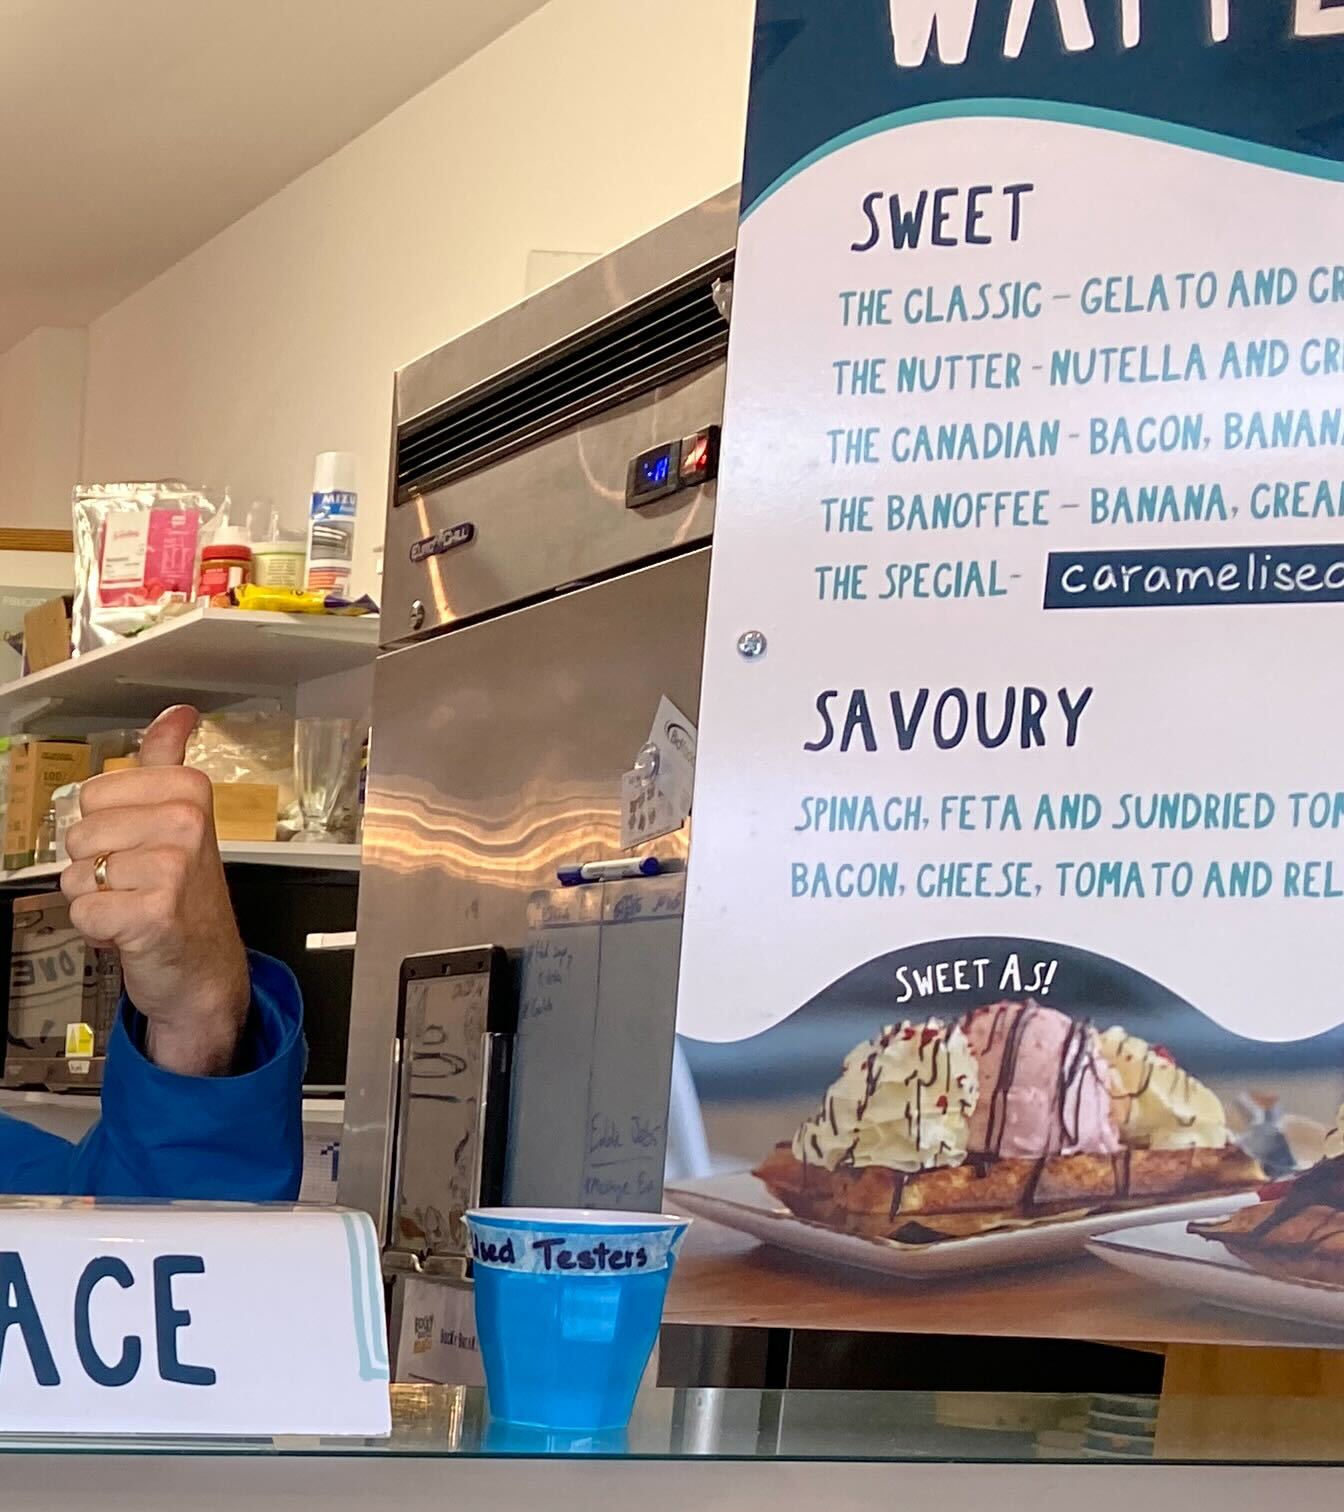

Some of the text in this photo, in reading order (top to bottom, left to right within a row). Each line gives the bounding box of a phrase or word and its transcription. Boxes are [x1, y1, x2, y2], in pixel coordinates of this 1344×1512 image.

[850, 183, 1034, 252] SWEET
[839, 271, 1219, 327] THE CLASSIC GELATO
[832, 342, 1207, 396] THE NUTTER NUTELLA
[827, 413, 1212, 465] THE CANADIAN BACON,
[821, 483, 1240, 533] THE BANOFFEE BANANA,
[804, 686, 1093, 753] SAVOURY
[794, 792, 1275, 833] SPINACH, FETA SUNDRIED
[790, 862, 1193, 899] BACON, CHEESE, TOMATO
[896, 954, 1058, 1003] SWEET AS!
[532, 1237, 650, 1272] Testers
